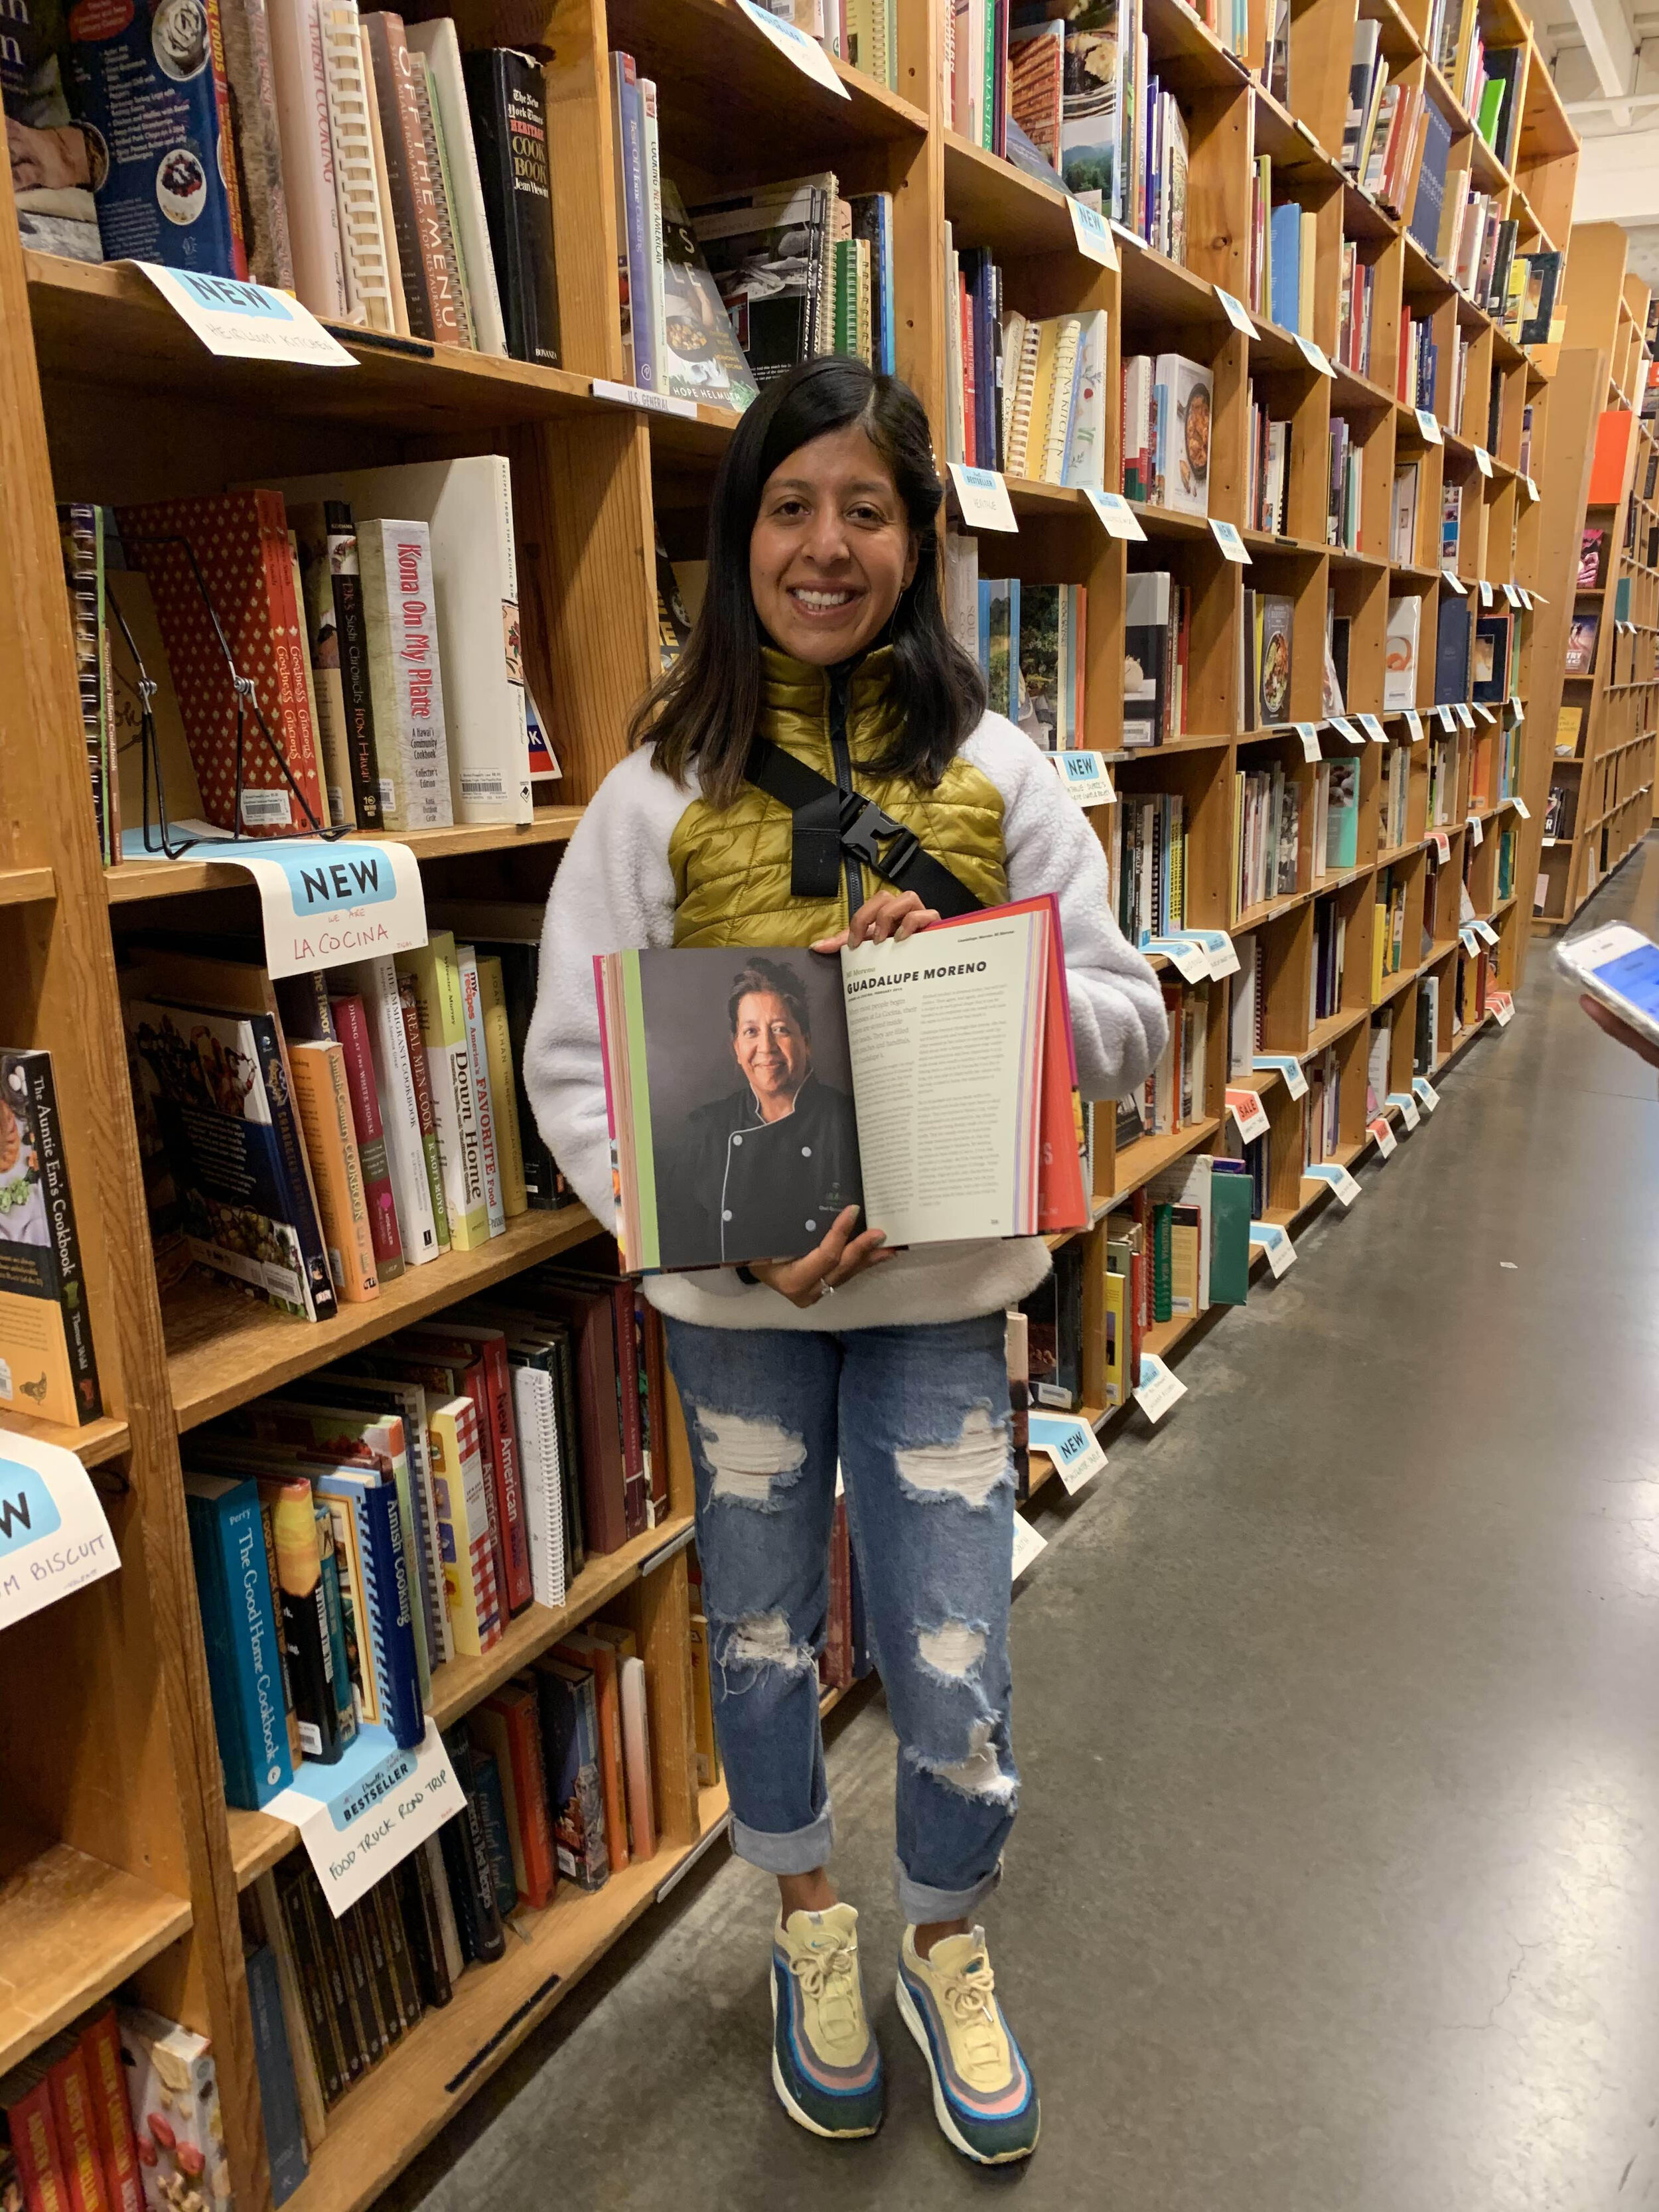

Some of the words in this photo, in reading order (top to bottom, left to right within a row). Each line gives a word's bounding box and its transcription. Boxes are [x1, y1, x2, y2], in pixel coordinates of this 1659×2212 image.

[508, 104, 527, 119] York
[527, 108, 544, 125] Times
[513, 89, 526, 104] The
[526, 93, 540, 108] New
[315, 88, 333, 184] COOKING
[403, 124, 415, 159] FROM
[510, 119, 545, 141] HERITAGE
[512, 135, 547, 164] COOK
[399, 46, 421, 123] OFF
[413, 142, 435, 206] THE
[427, 218, 458, 327] MENU
[513, 157, 547, 185] BOOK
[514, 177, 531, 192] Jean
[632, 165, 642, 202] Home
[652, 188, 662, 213] NEW
[1079, 206, 1102, 230] NEW
[420, 228, 431, 251] TOP
[634, 205, 644, 254] Cooking
[654, 213, 663, 265] AMERICAN
[183, 273, 271, 310] NEW
[425, 254, 444, 329] RESTAURANTS
[803, 292, 812, 352] AMERICAN
[813, 294, 822, 352] AMERICAN
[628, 390, 641, 404] U.S.
[642, 392, 670, 411] GENERAL
[673, 386, 699, 398] HOPE
[700, 388, 742, 402] HELMUTH
[396, 542, 423, 594] Kona
[344, 615, 358, 642] Sushi
[400, 600, 428, 628] On
[399, 633, 431, 664] My
[276, 645, 294, 703] Goodness
[289, 645, 307, 703] Goodness
[407, 668, 434, 720] Plate
[108, 723, 117, 771] Cookbook
[410, 737, 438, 755] Community
[411, 728, 416, 737] A
[413, 748, 437, 761] Cookbook
[1068, 758, 1093, 776] NEW
[419, 778, 437, 789] Edition
[300, 859, 379, 903] NEW
[328, 915, 340, 924] WE
[348, 908, 366, 919] ARE
[294, 938, 316, 960] LA
[319, 923, 390, 954] COCINA
[313, 970, 325, 992] The
[386, 966, 396, 990] THE
[443, 954, 453, 999] Sylvester
[470, 971, 477, 992] my
[847, 971, 919, 995] GUADALUPE
[923, 960, 987, 981] MORENO
[853, 966, 876, 978] Moreno
[318, 993, 332, 1034] Flavor
[447, 999, 457, 1026] Murray
[464, 972, 476, 1021] recipes
[387, 1023, 397, 1049] America
[389, 990, 406, 1057] IMMIGRANT
[405, 1011, 419, 1044] REAL
[491, 974, 501, 1007] JOAN
[496, 1014, 508, 1064] NATHAN
[886, 1017, 903, 1027] inside
[894, 1027, 909, 1035] filled
[33, 1075, 44, 1102] The
[348, 1004, 359, 1041] DINING
[354, 1041, 361, 1052] AT
[359, 1071, 369, 1100] WHITE
[365, 1101, 375, 1135] HOUSE
[413, 1051, 427, 1089] MEN
[455, 1050, 472, 1121] Down
[400, 1057, 416, 1130] COOKBOOK
[1239, 1099, 1257, 1118] SALE
[37, 1103, 54, 1159] Auntie
[419, 1090, 433, 1137] COOK
[469, 1026, 481, 1075] America's
[475, 1076, 494, 1176] FAVORITE
[486, 1178, 498, 1209] Food
[332, 1054, 348, 1142] Amish-Country
[345, 1141, 364, 1220] COOKBOOK
[45, 1157, 66, 1197] Em's
[463, 1131, 482, 1199] Home
[433, 1181, 444, 1215] MOYO
[51, 1197, 72, 1278] Cookbook
[625, 1341, 634, 1372] COOKS
[496, 1392, 510, 1434] New
[1060, 1432, 1084, 1459] NEW
[500, 1436, 520, 1522] American
[229, 1507, 252, 1526] Perry
[482, 1461, 499, 1548] American
[238, 1527, 253, 1568] The
[387, 1499, 405, 1560] Amish
[30, 1534, 107, 1582] BISCUIT
[266, 1554, 279, 1592] TRUCK
[244, 1568, 261, 1624] Good
[271, 1591, 284, 1627] ROAD
[394, 1556, 411, 1628] Cooking
[249, 1621, 265, 1674] Home
[257, 1678, 279, 1763] Cookbook
[342, 1762, 409, 1822] BESTSELLER
[328, 1850, 357, 1881] FOOD
[357, 1818, 397, 1854] TRUCK
[397, 1792, 425, 1820] ROAD
[424, 1768, 448, 1793] TRIP
